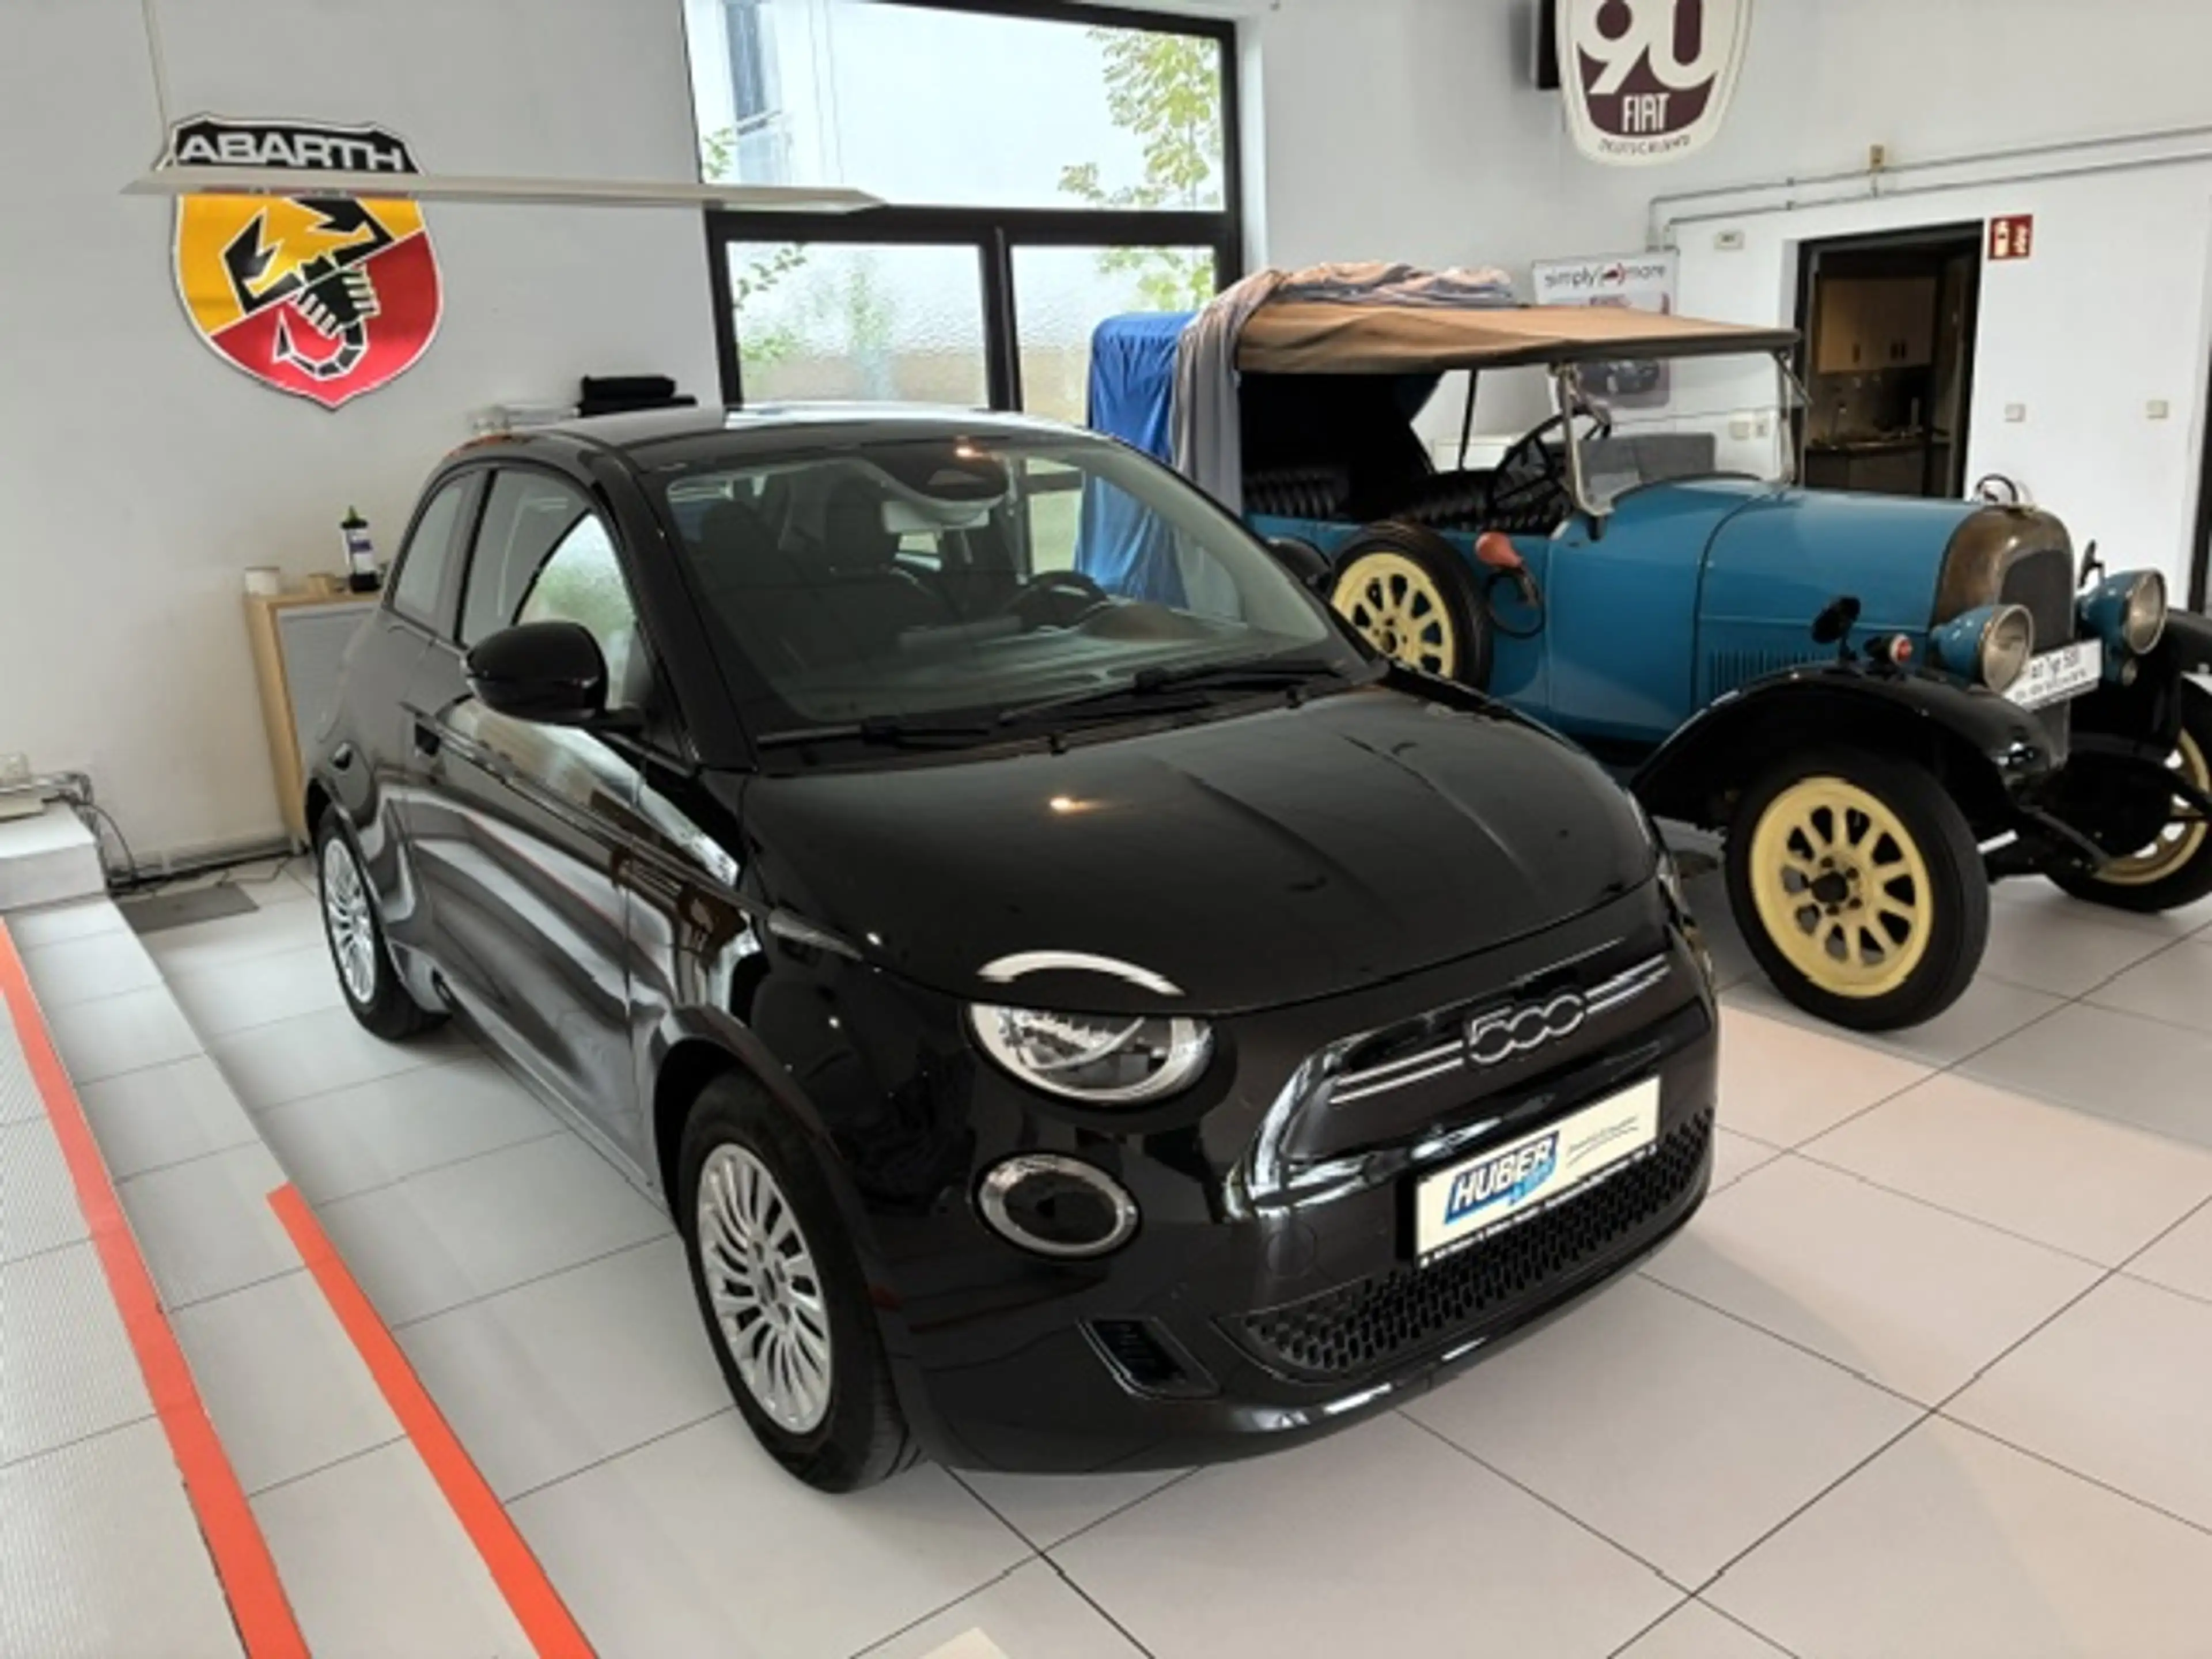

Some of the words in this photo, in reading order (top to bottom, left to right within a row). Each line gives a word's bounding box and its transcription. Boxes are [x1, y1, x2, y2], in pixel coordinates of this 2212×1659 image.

[1623, 93, 1671, 133] FIAT
[180, 132, 403, 171] ABARTH
[1469, 994, 1584, 1065] 500
[1452, 1135, 1554, 1213] HUBER
